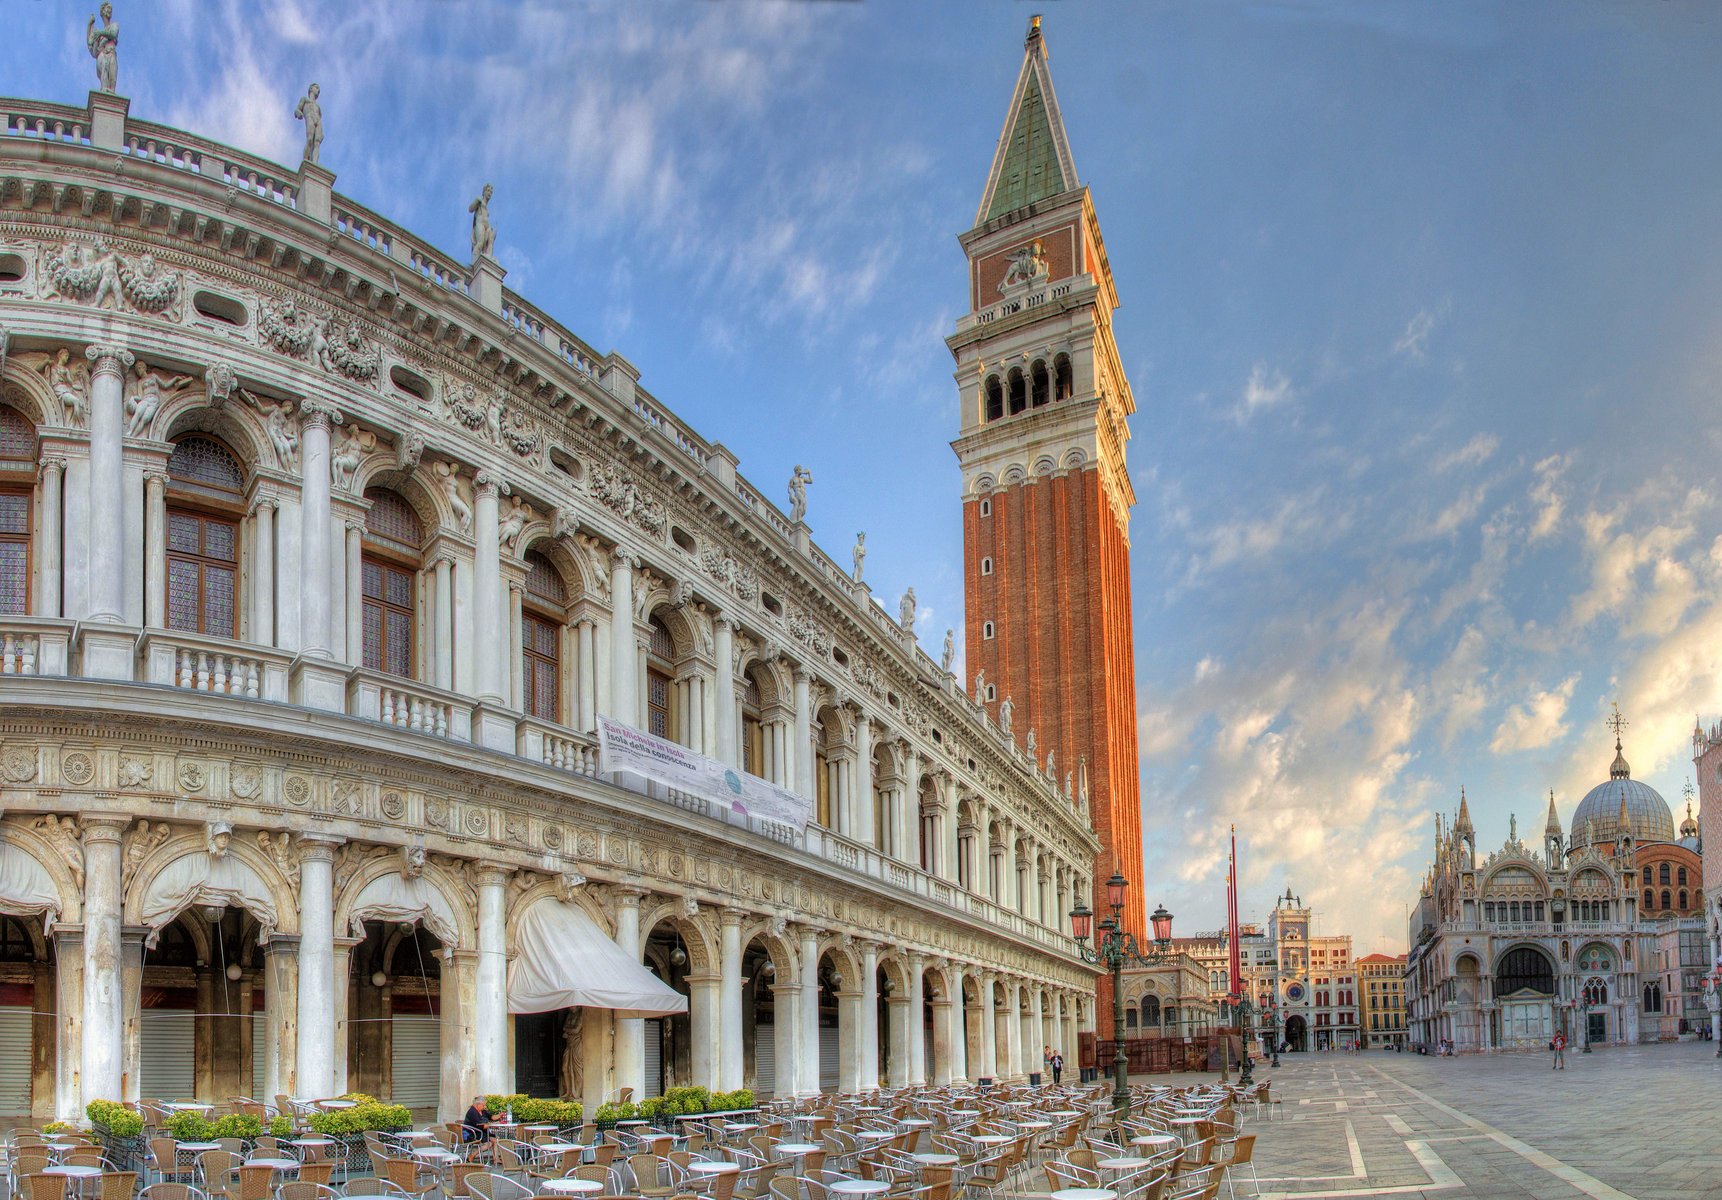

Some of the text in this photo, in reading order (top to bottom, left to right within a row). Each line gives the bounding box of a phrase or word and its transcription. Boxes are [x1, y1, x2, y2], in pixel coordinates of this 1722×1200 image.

[603, 722, 621, 734] San
[623, 729, 655, 748] Michele
[606, 731, 626, 746] Isola
[628, 741, 650, 754] della
[652, 750, 697, 771] conoscenza
